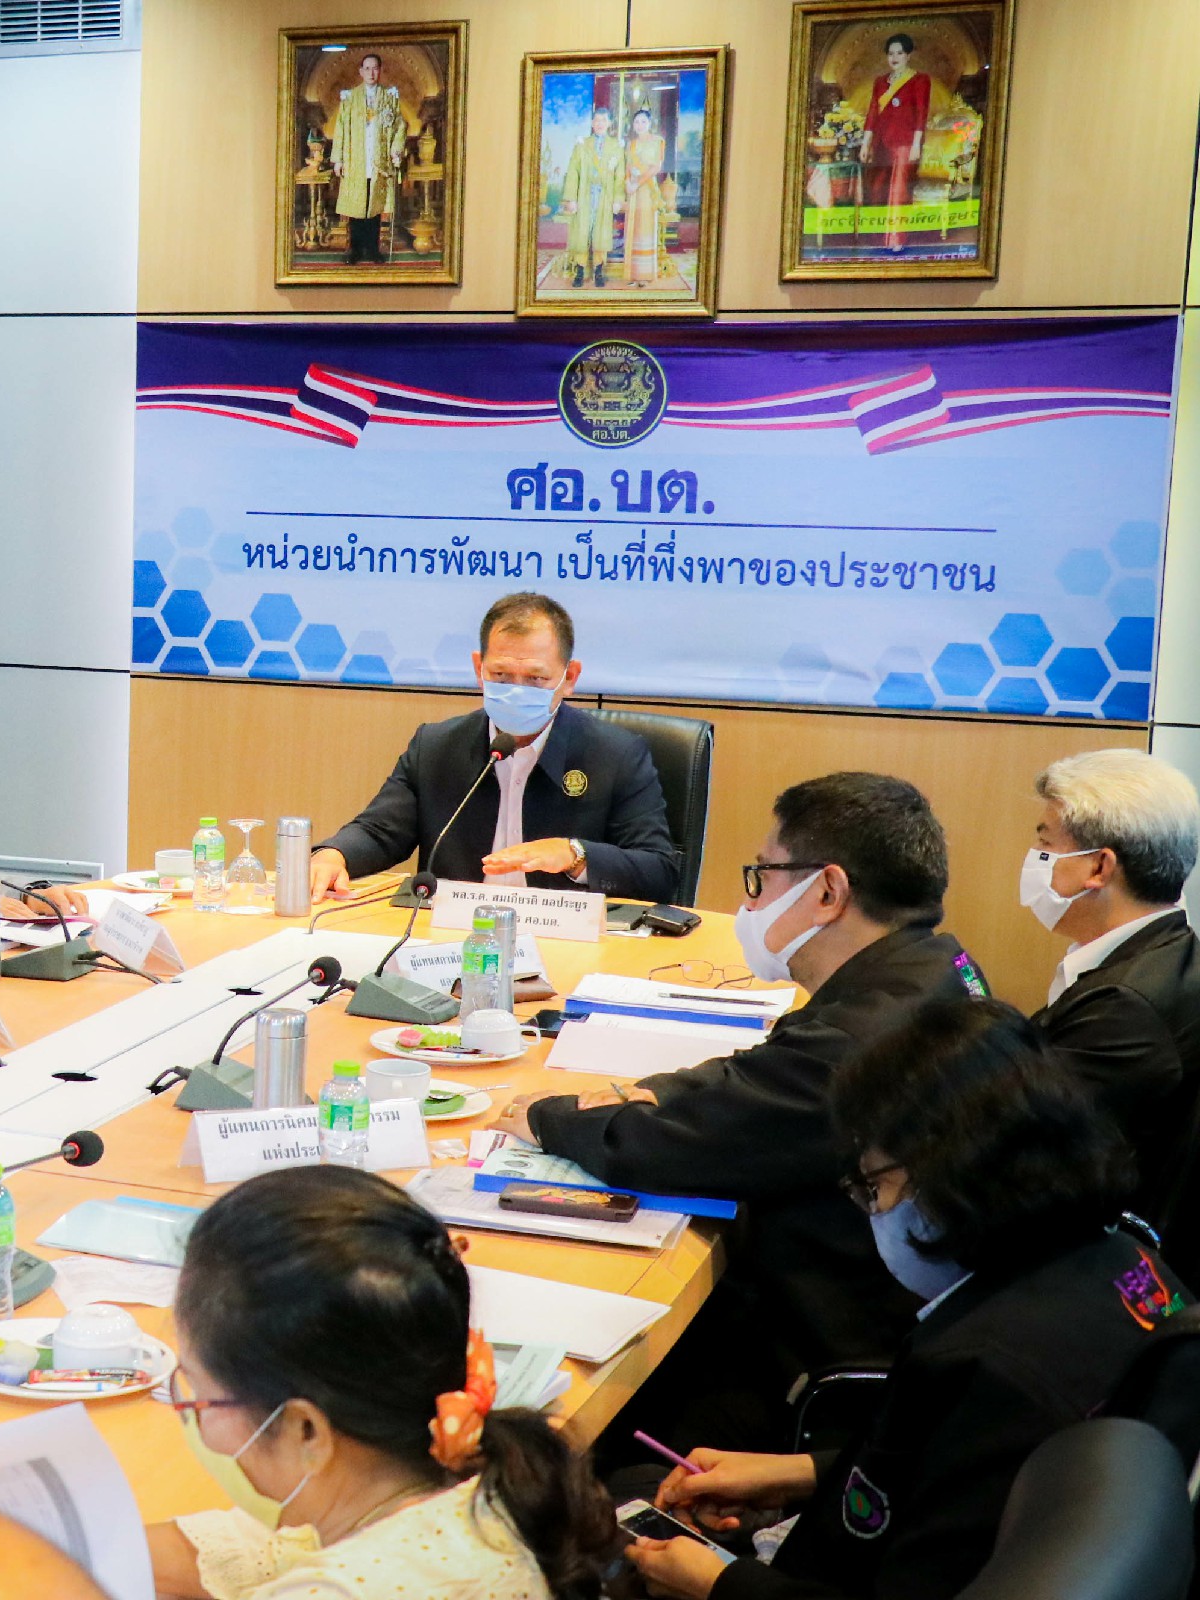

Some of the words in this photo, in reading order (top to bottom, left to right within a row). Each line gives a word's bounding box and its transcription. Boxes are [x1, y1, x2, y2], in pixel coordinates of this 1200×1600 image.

[592, 429, 631, 440] ศอ.บต.
[505, 462, 716, 515] ศอ.บต.
[242, 533, 543, 579] หน่วยนำการพัฒนา
[557, 529, 997, 593] เป็นที่พึ่งพาของประชาชน
